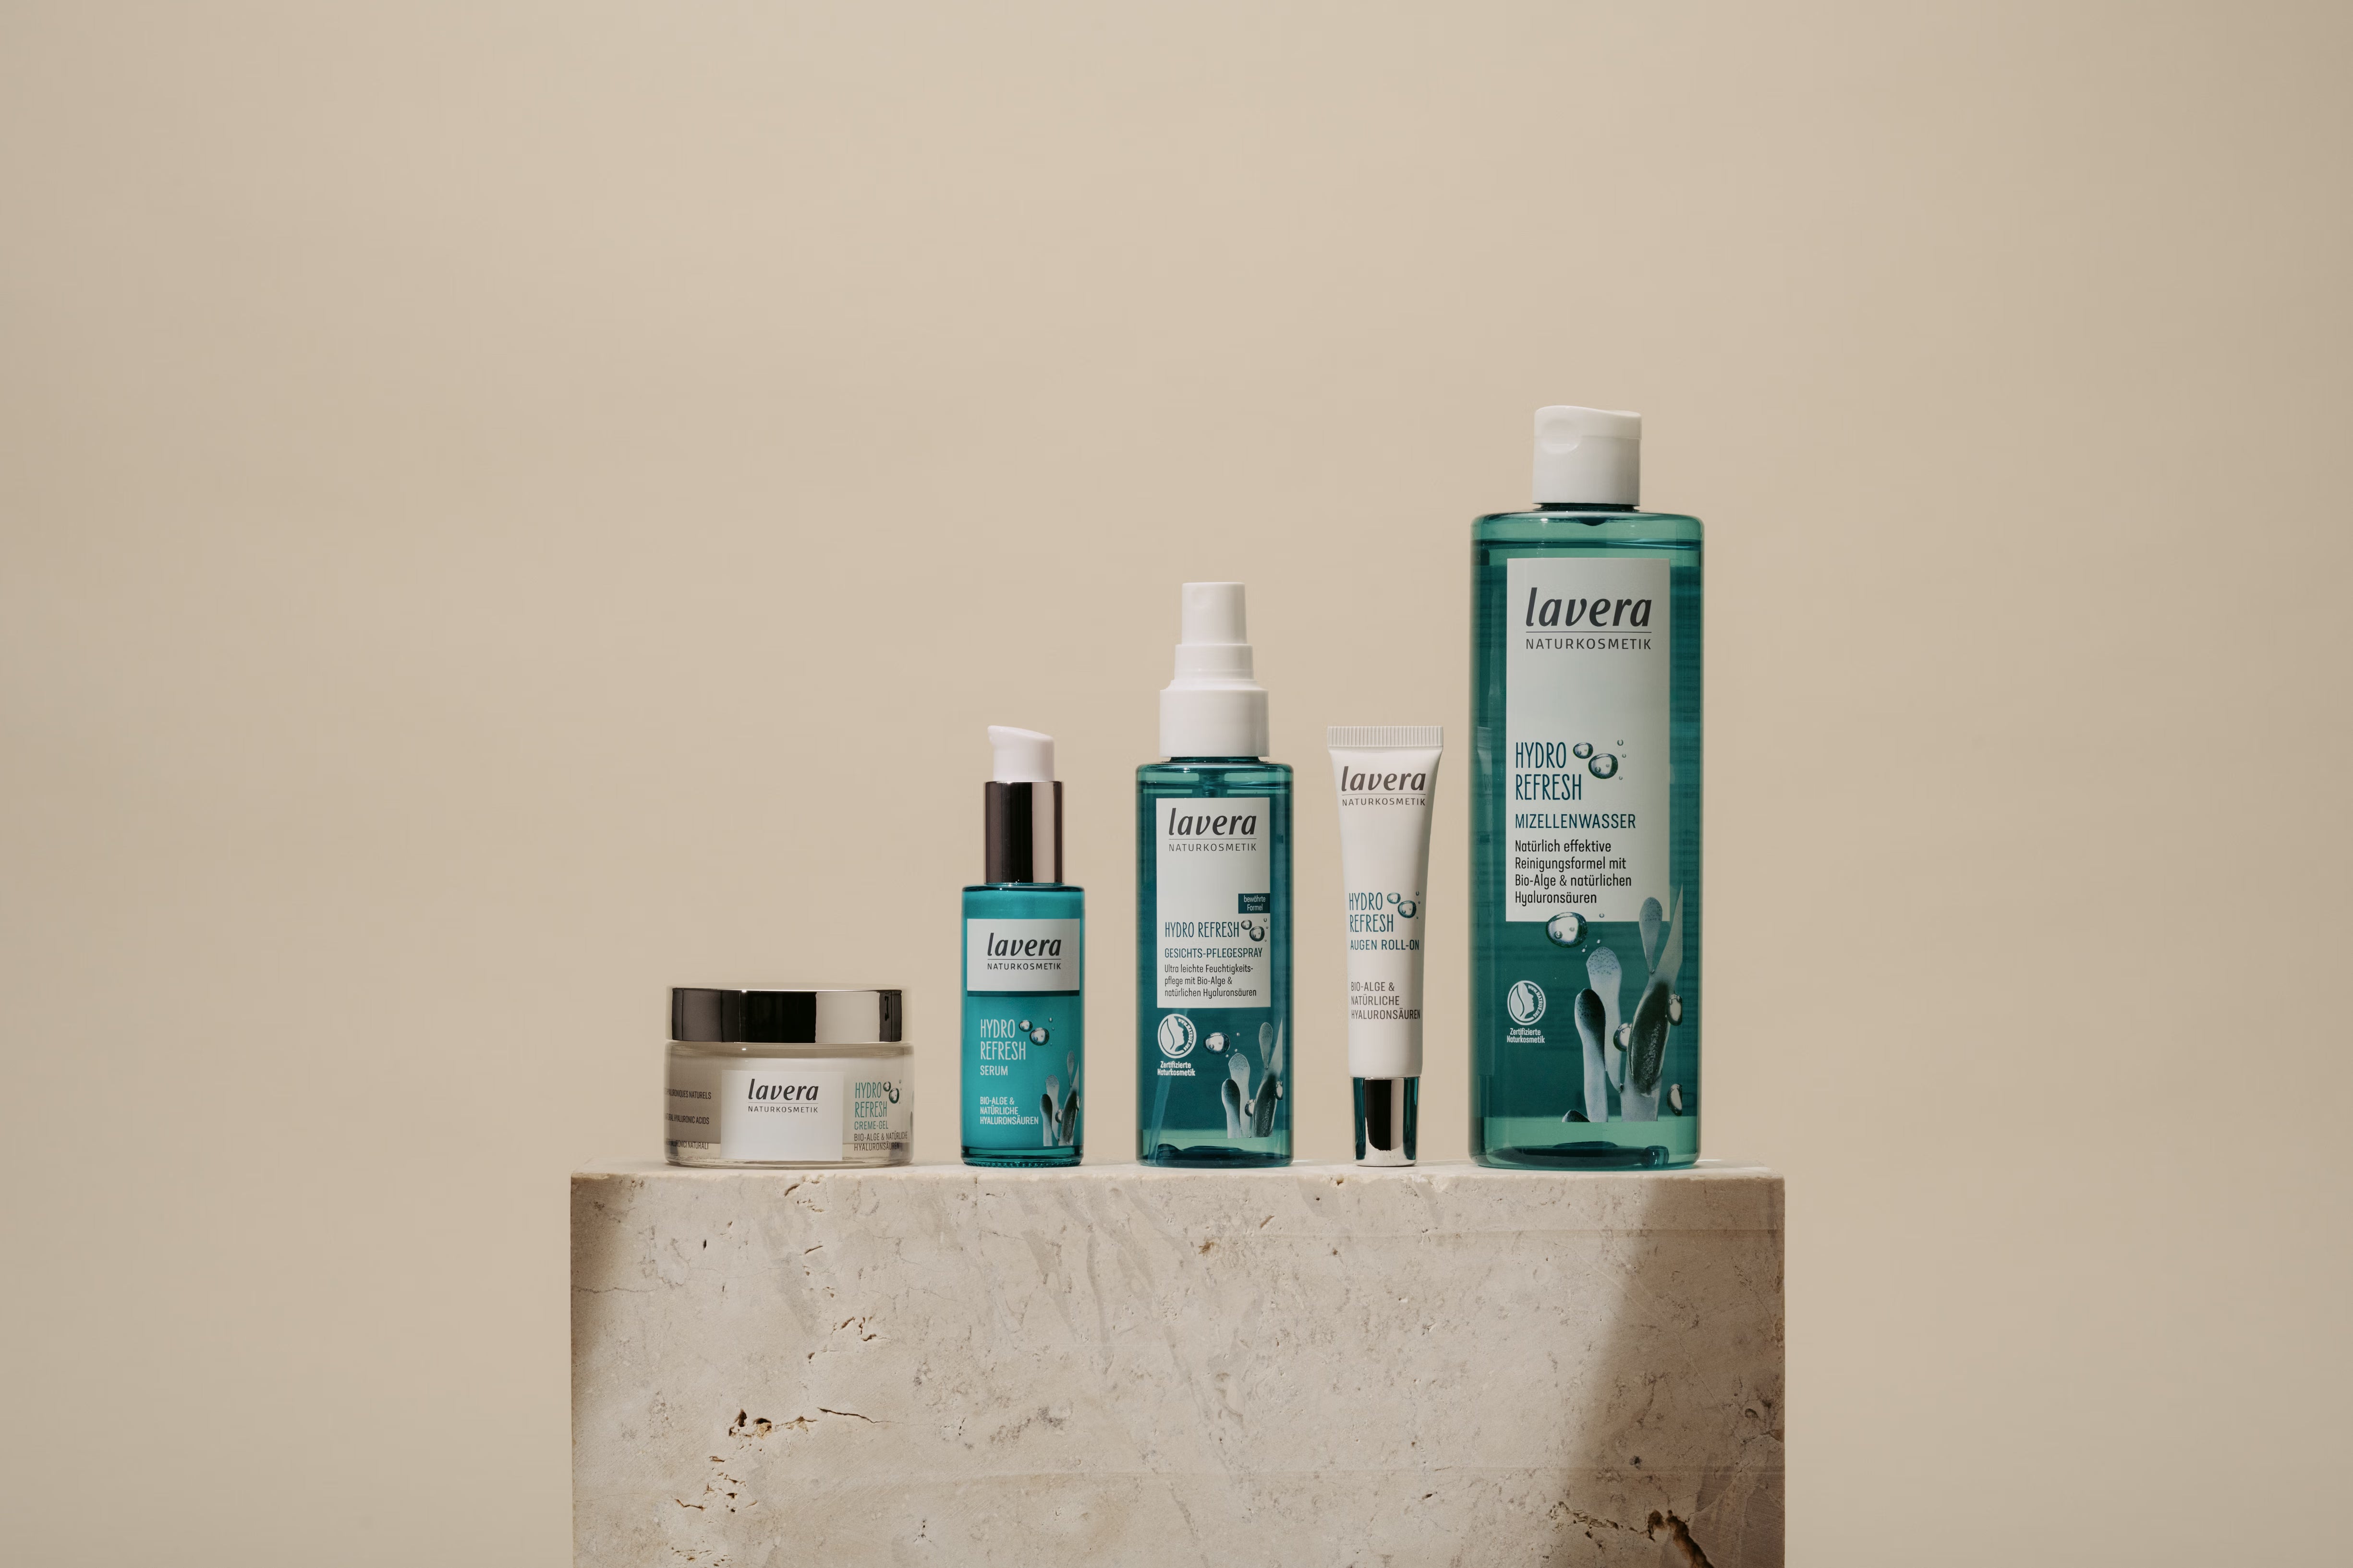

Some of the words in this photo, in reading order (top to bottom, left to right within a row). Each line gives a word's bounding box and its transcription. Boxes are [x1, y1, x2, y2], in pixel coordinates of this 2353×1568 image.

[1526, 587, 1652, 627] lavera
[1526, 639, 1651, 650] NATURKOSMETIK
[1516, 742, 1566, 769] HYDRO
[1341, 766, 1426, 792] lavera
[1516, 773, 1582, 800] REFRESH
[1342, 798, 1425, 807] NATURKOSMETIK
[1169, 808, 1257, 835] lavera
[1516, 814, 1636, 829] MIZELLENWASSER
[1169, 843, 1256, 852] NATURKOSMETIK
[1515, 839, 1560, 852] Natürlich
[1564, 839, 1611, 852] effektive
[1515, 856, 1605, 872] Reinigungsformel
[1609, 857, 1626, 869] mit
[1515, 874, 1556, 890] Bio-Alge
[1559, 874, 1567, 886] &
[1570, 873, 1632, 886] natürlichen
[1349, 892, 1383, 910] HYDRO
[1515, 890, 1597, 906] Hyaluronsäuren
[1350, 914, 1394, 932] REFRESH
[1165, 921, 1194, 937] HYDRO
[1198, 921, 1239, 937] REFRESH
[987, 932, 1061, 956] lavera
[1350, 940, 1377, 950] AUGEN
[1381, 940, 1419, 950] ROLL-ON
[1165, 948, 1262, 958] GESICHTS-PFLEGESPRAY
[1165, 964, 1178, 973] Ultra
[1180, 964, 1203, 973] leichte
[1206, 964, 1253, 975] Feuchtigkeits-
[1165, 976, 1183, 987] pflege
[1197, 976, 1225, 987] Bio-Alge
[1227, 977, 1232, 985] &
[1351, 982, 1385, 991] BIO-ALGE
[1388, 982, 1395, 991] &
[1165, 988, 1201, 997] natürlichen
[1203, 988, 1257, 999] Hyaluronsäuren
[1351, 994, 1399, 1005] NATÜRLICHE
[1528, 984, 1543, 1018] WWW.NATRUE.ORG
[1351, 1008, 1420, 1019] HYALURONSÄUREN
[980, 1019, 1016, 1038] HYDRO
[1510, 1027, 1541, 1036] Zertifizierte
[1507, 1035, 1545, 1043] Naturkosmetik
[980, 1041, 1026, 1060] REFRESH
[980, 1065, 1008, 1075] SERUM
[1160, 1061, 1191, 1069] Zertifizierte
[748, 1078, 819, 1100] lavera
[855, 1082, 882, 1098] HYDRO
[689, 1091, 712, 1099] NATURELS
[980, 1097, 1007, 1105] BIO-ALGE
[1009, 1097, 1015, 1105] &
[855, 1101, 887, 1118] REFRESH
[980, 1105, 1019, 1115] NATÜRLICHE
[695, 1116, 710, 1124] ACIDS
[854, 1120, 888, 1130] CREME-GEL
[980, 1115, 1039, 1125] HYALURONSÄUREN
[854, 1133, 880, 1141] BIO-ALGE
[886, 1131, 908, 1140] NATÜRLICHE
[688, 1141, 709, 1150] NATURALI
[854, 1141, 899, 1151] HYALURONSÄUREN
